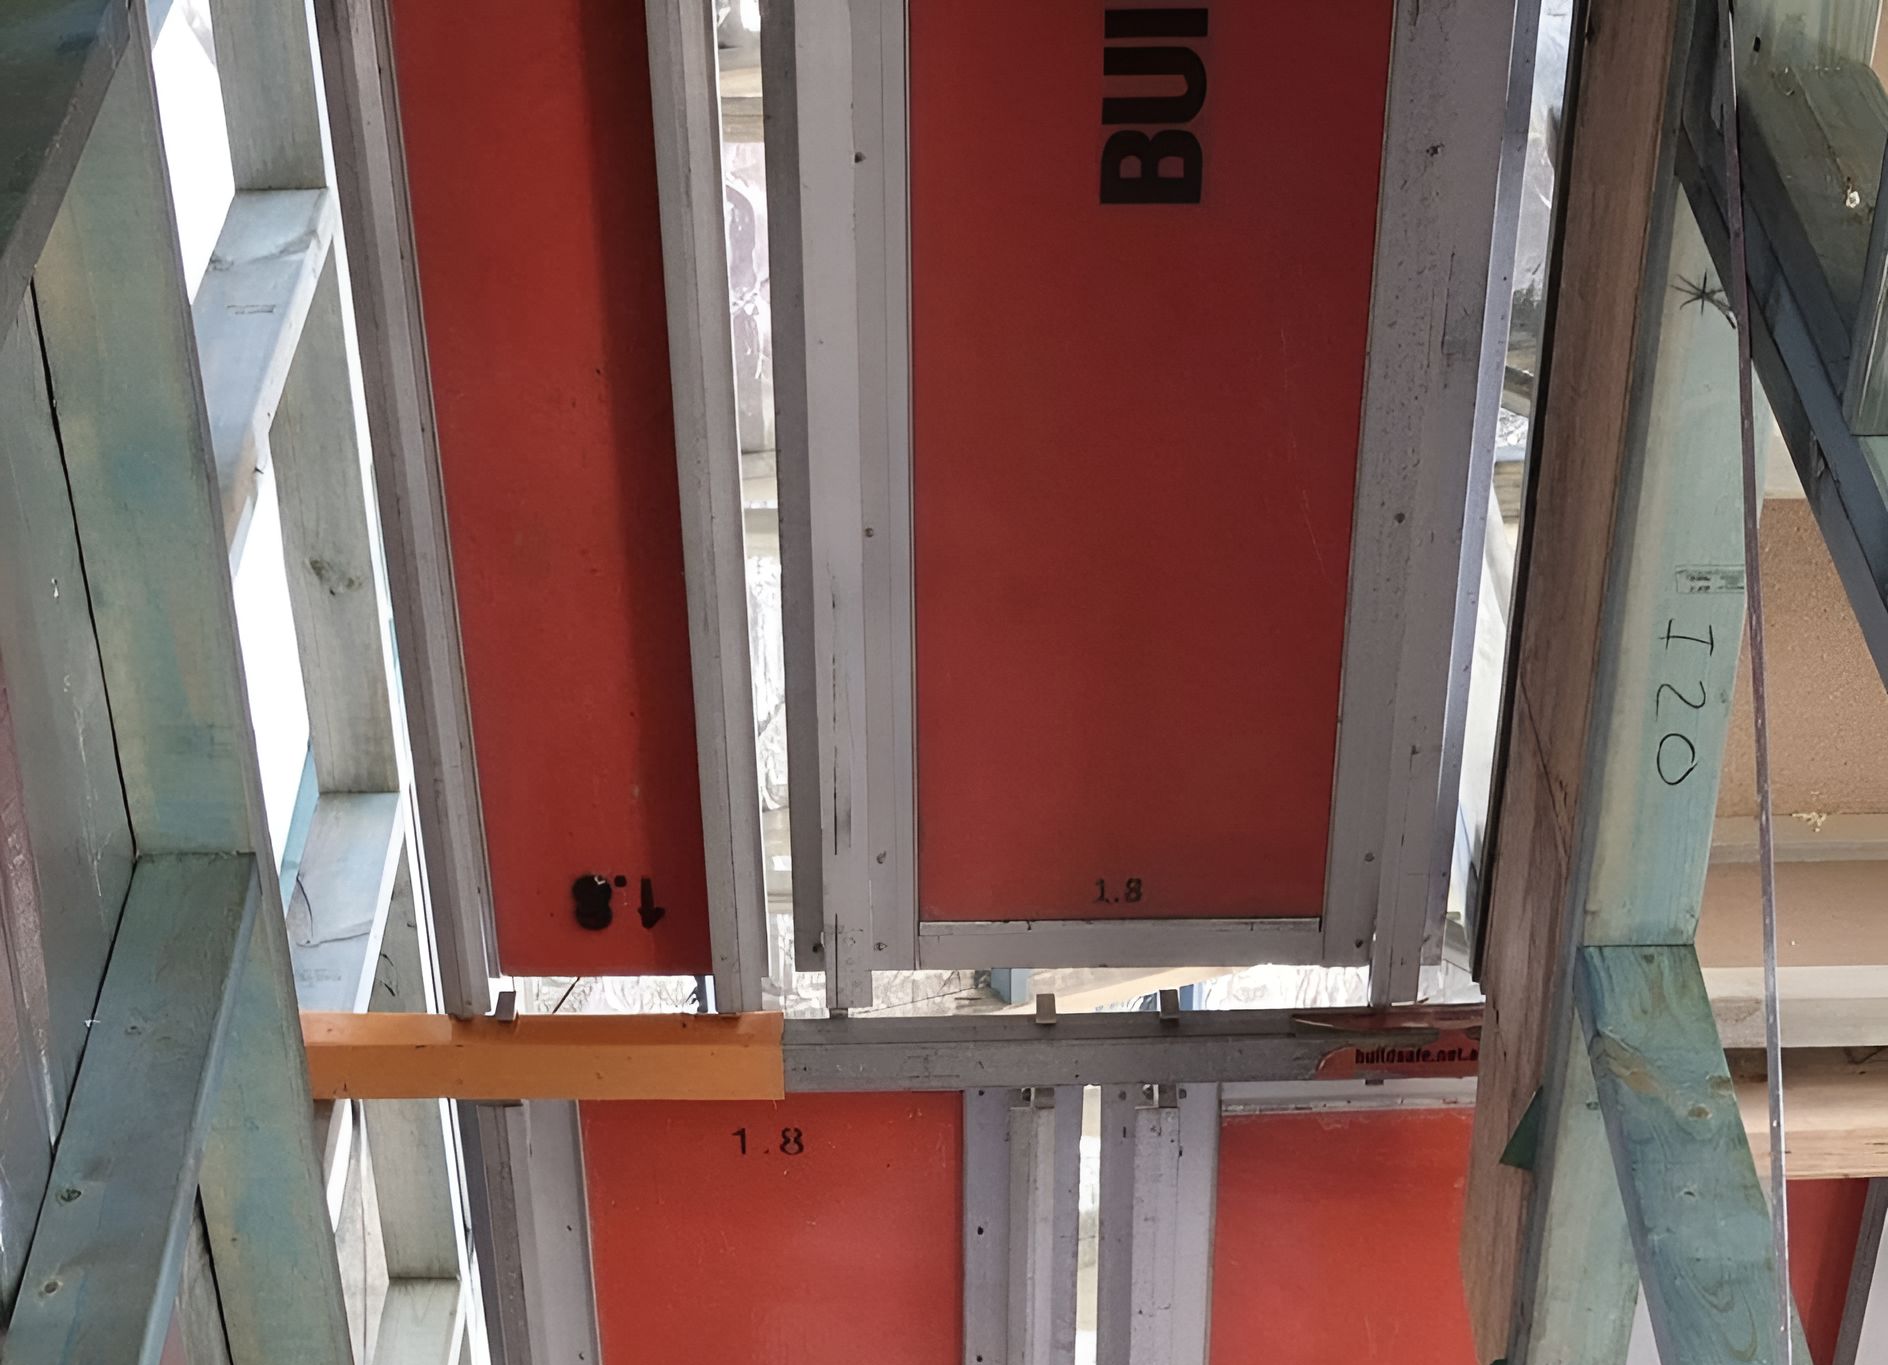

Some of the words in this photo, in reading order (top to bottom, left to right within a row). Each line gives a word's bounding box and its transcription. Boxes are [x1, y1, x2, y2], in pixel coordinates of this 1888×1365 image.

[1100, 8, 1208, 204] BUI
[1094, 877, 1143, 903] 1.8
[731, 1127, 804, 1156] 1.8
